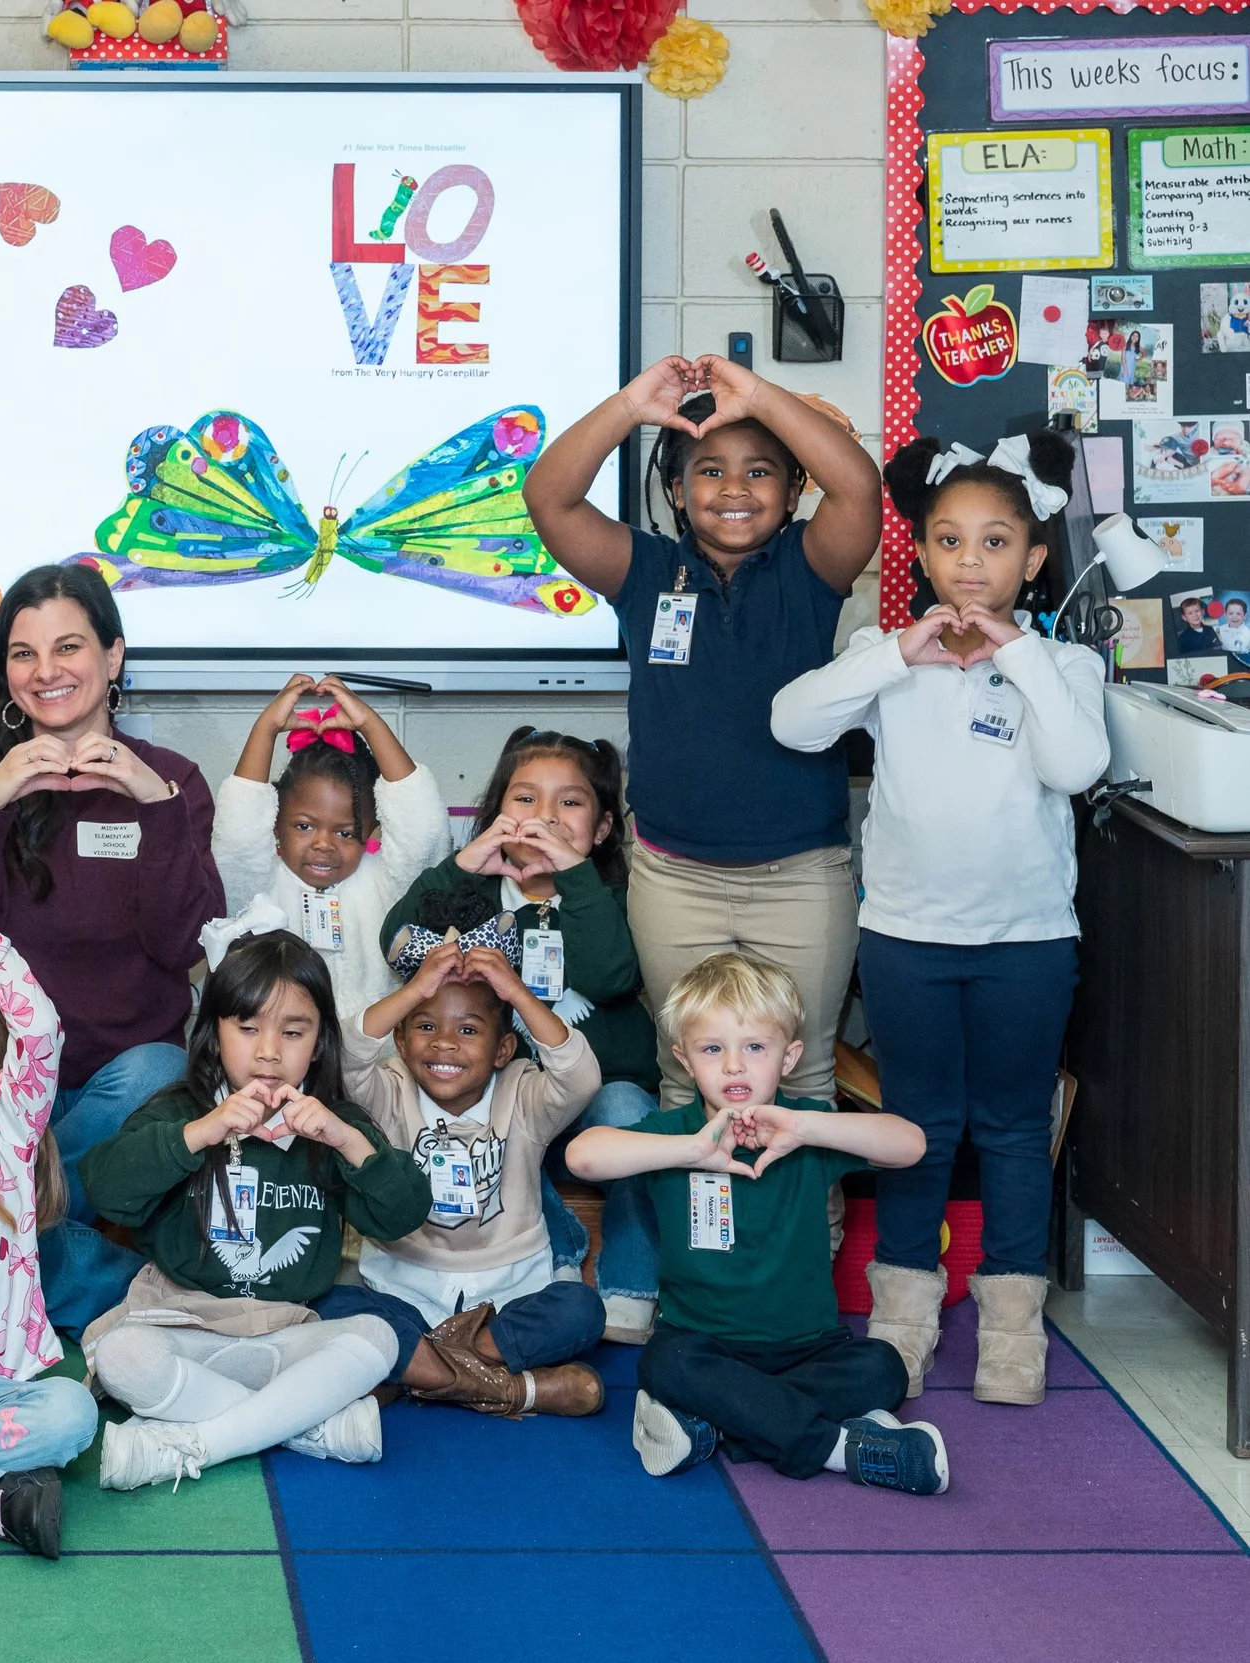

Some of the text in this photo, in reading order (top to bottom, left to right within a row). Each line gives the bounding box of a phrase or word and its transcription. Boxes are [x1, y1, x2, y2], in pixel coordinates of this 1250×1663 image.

[1003, 52, 1239, 91] This weeks focus:
[355, 144, 374, 152] New
[376, 144, 395, 152] York
[398, 144, 423, 152] Times
[424, 144, 467, 152] Bestseller
[982, 143, 1048, 170] ELA:
[1144, 177, 1210, 190] Measurable
[944, 190, 1086, 208] Segmenting sentences into
[944, 206, 978, 216] words
[1145, 208, 1195, 222] Counting
[945, 218, 1008, 232] Recognizing
[1035, 216, 1073, 224] names
[1146, 222, 1209, 235] Quantity 0-3
[1147, 235, 1193, 250] Subitizing
[938, 318, 1007, 349] THANKS,
[941, 332, 1014, 366] TEACHER!
[331, 368, 491, 379] from The Very Hungry Caterpillar
[720, 1219, 729, 1240] CARD
